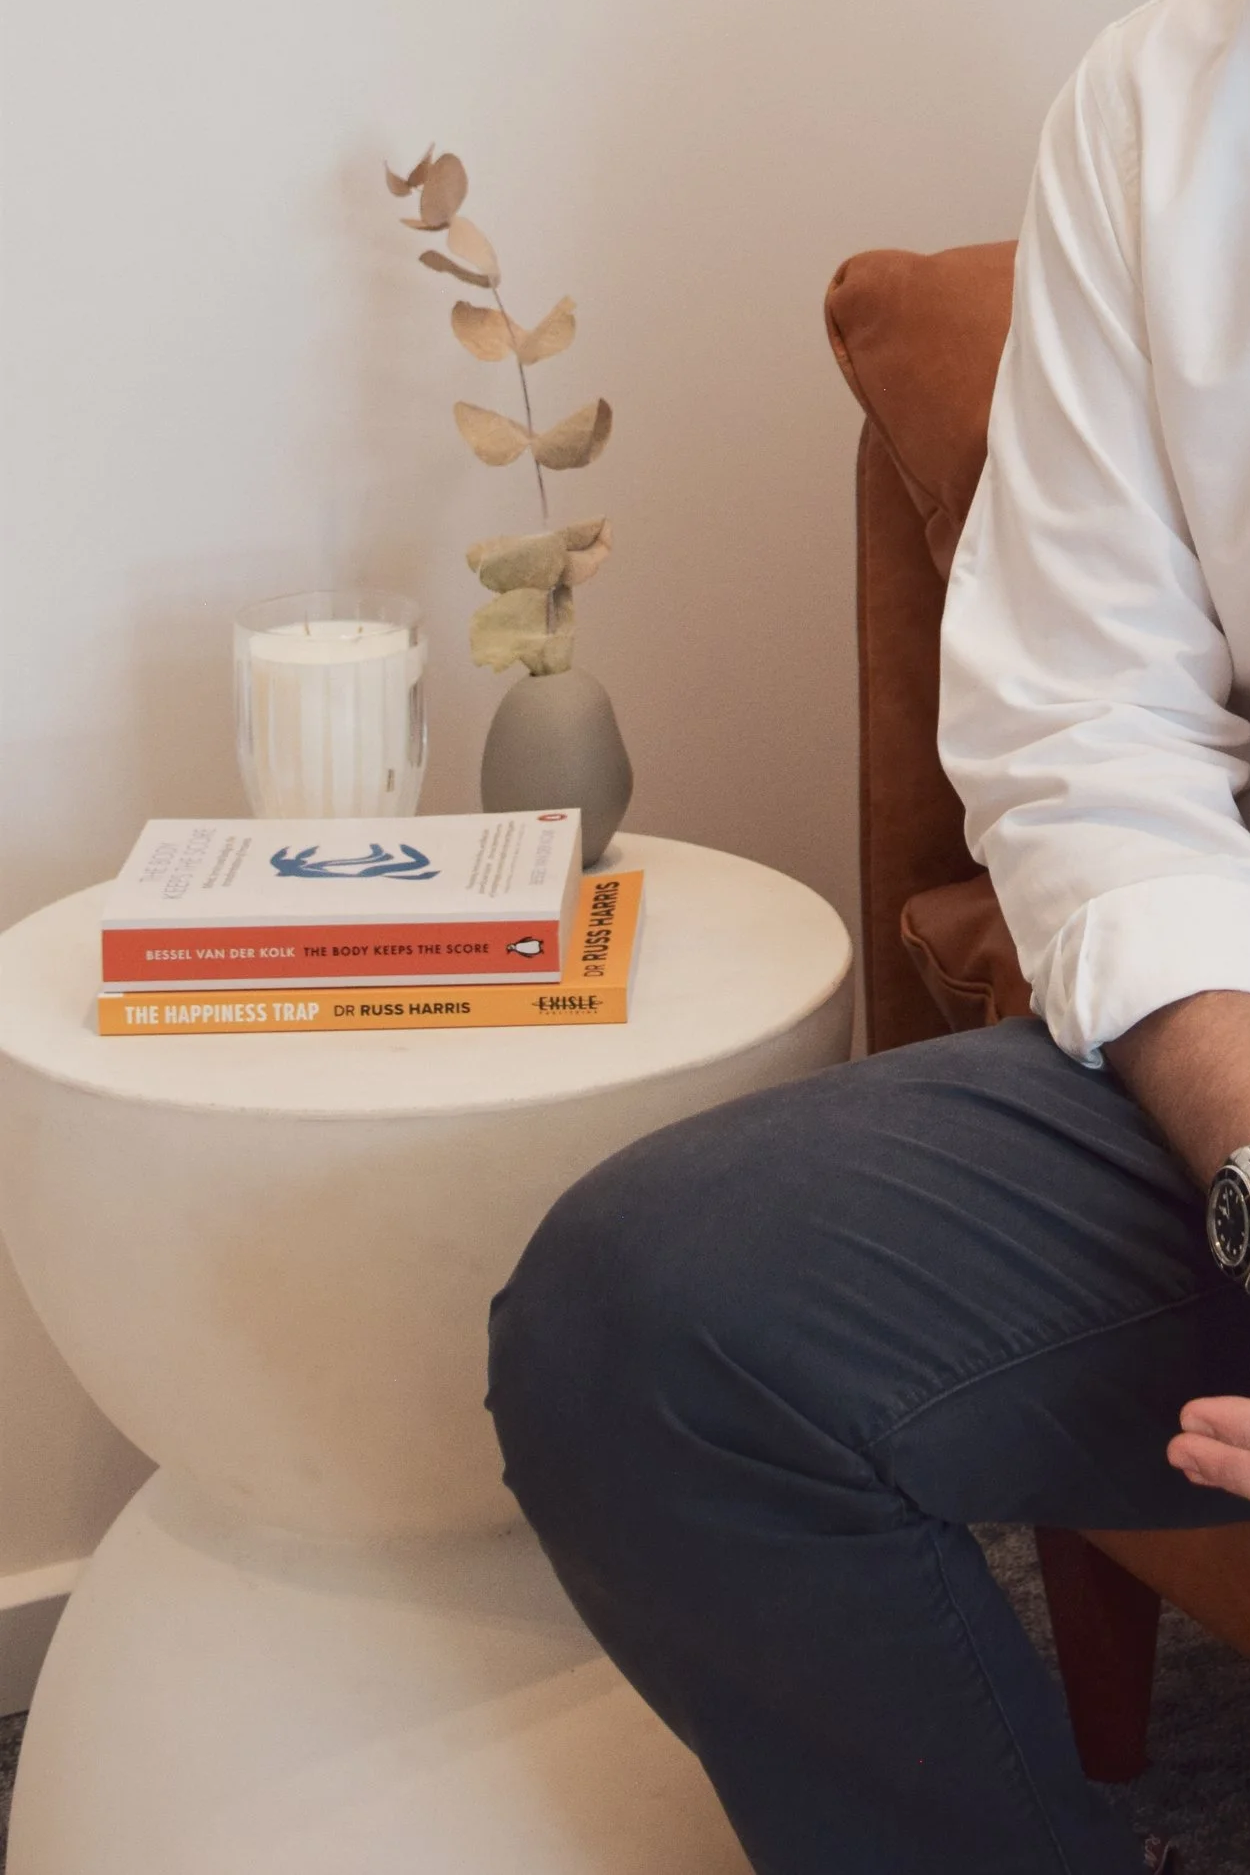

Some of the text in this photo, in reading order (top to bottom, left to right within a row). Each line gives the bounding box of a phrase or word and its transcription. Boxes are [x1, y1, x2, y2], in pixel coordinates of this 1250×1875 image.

[582, 881, 620, 977] DR RUSS HARRIS
[146, 943, 489, 961] BESSEL VAN DER KOLK THE BODY KEEPS THE SCORE
[539, 995, 597, 1010] EXISLE
[125, 1002, 471, 1024] THE HAPPINESS TRAP DR RUSS HARRIS
